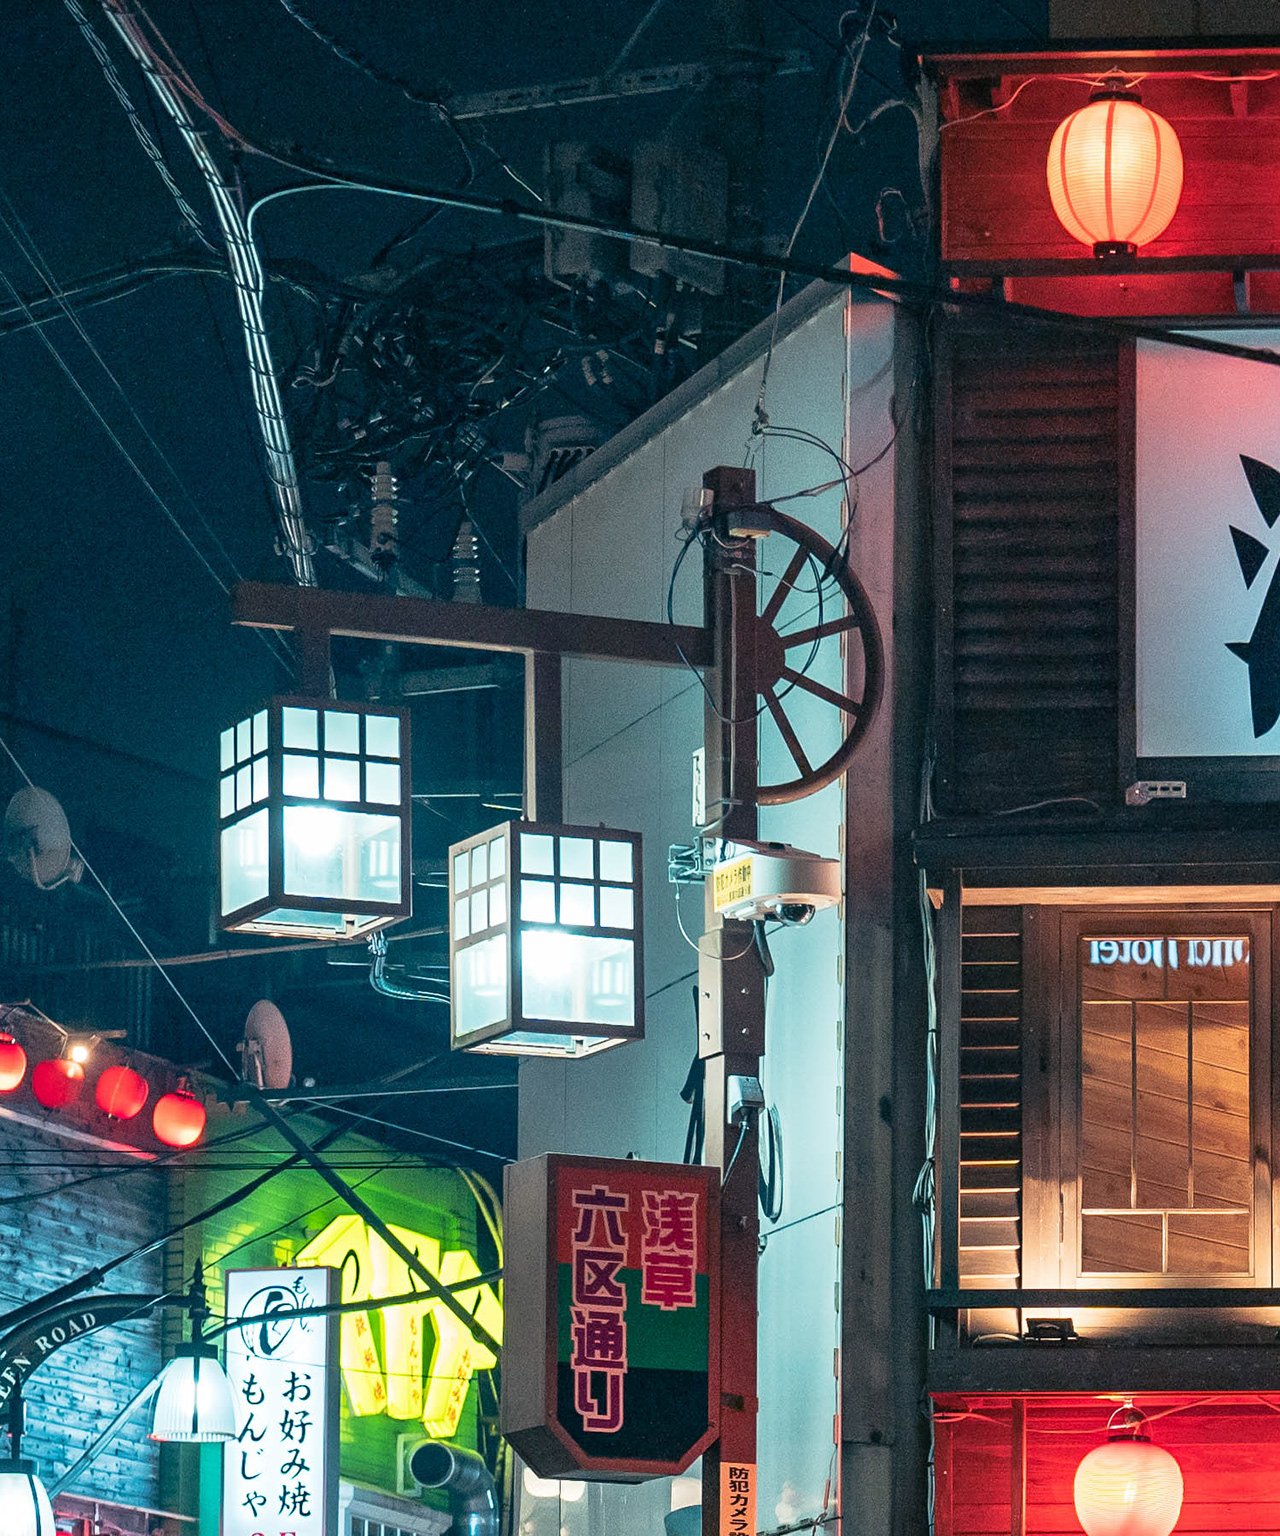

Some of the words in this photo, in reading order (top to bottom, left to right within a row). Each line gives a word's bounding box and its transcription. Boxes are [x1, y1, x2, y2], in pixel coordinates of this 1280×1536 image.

[571, 1184, 629, 1434] 六区通り
[642, 1190, 698, 1311] 浅草
[34, 1313, 96, 1354] ROAD
[239, 1372, 267, 1519] もんじゃ
[278, 1371, 312, 1518] お好み焼
